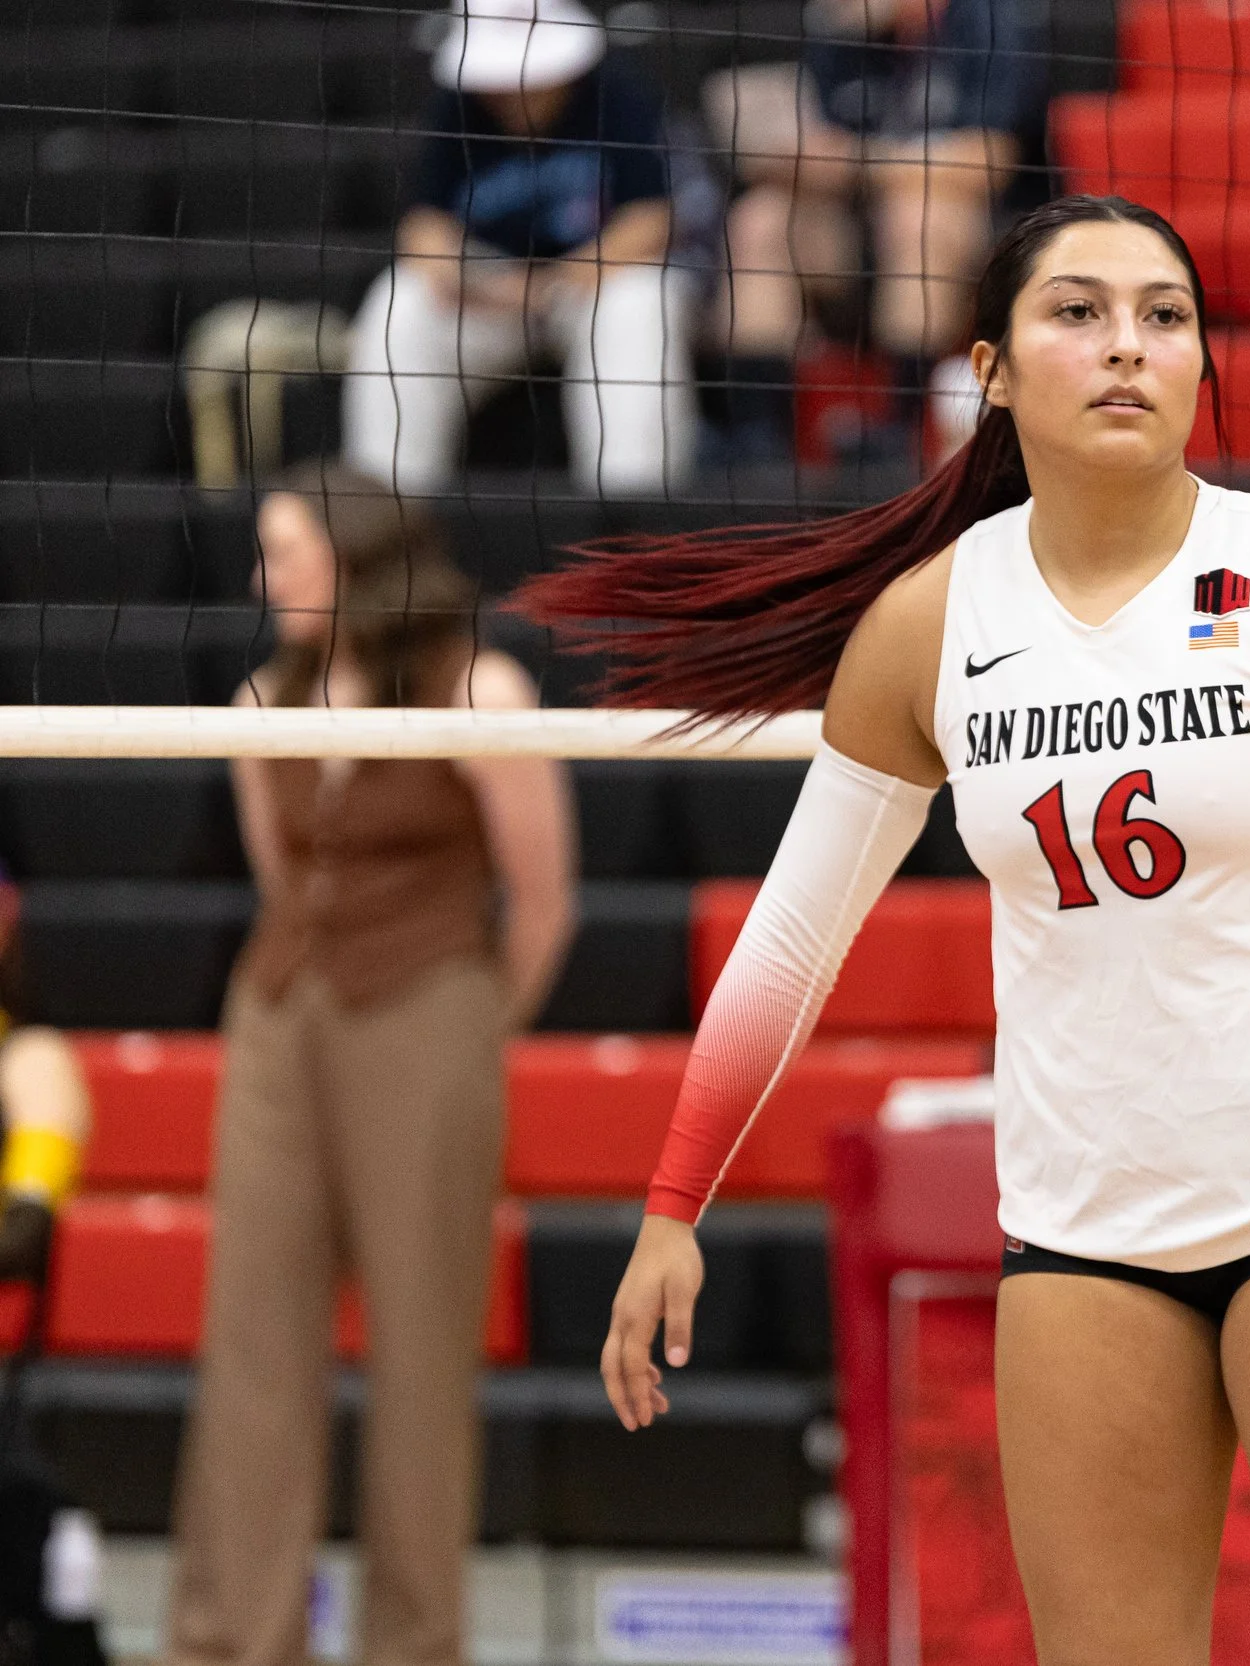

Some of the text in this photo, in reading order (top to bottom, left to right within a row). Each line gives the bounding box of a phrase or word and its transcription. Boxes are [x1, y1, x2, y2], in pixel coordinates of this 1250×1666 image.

[965, 708, 1017, 769] SAN
[1021, 696, 1128, 761] DIEGO
[1020, 769, 1187, 911] 16
